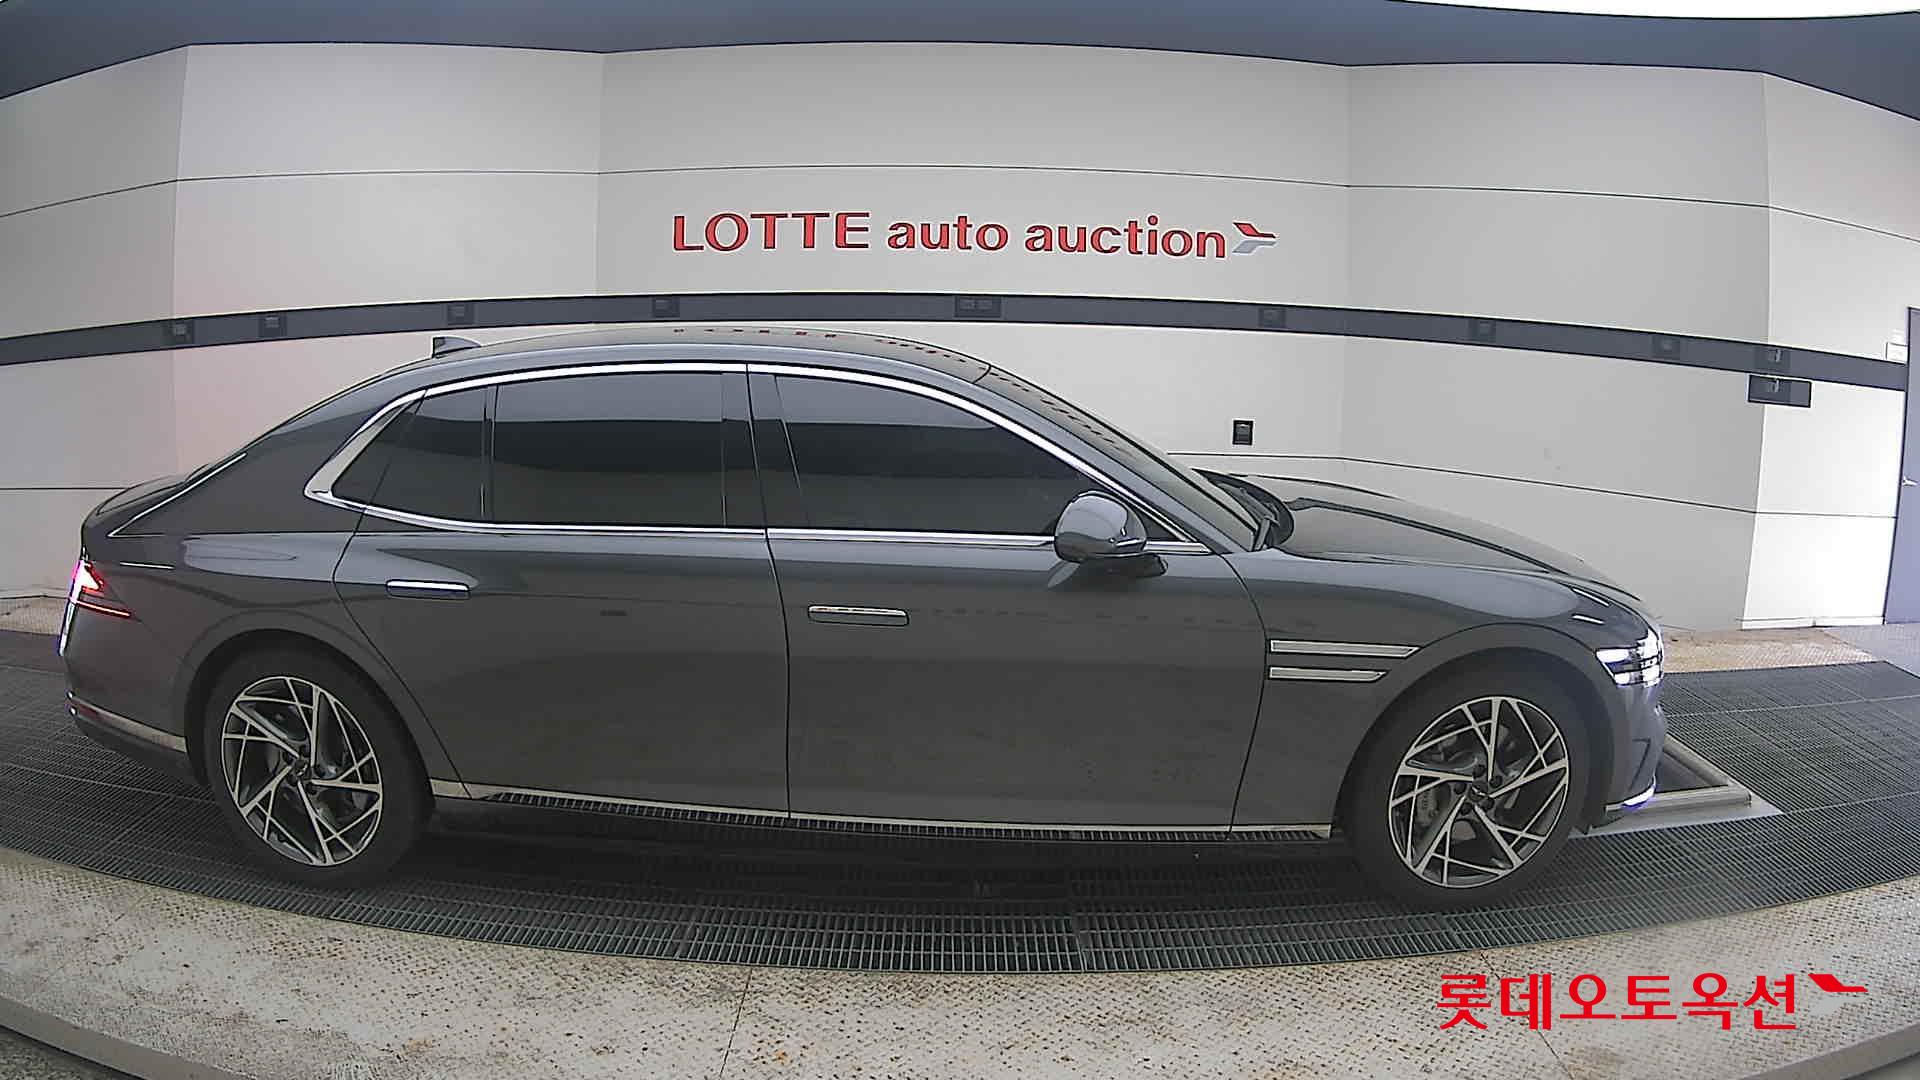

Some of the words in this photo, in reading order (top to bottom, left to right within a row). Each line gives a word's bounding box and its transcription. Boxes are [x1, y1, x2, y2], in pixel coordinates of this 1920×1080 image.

[673, 212, 870, 251] LOTTE
[887, 216, 1009, 251] auto
[1025, 215, 1226, 258] auction
